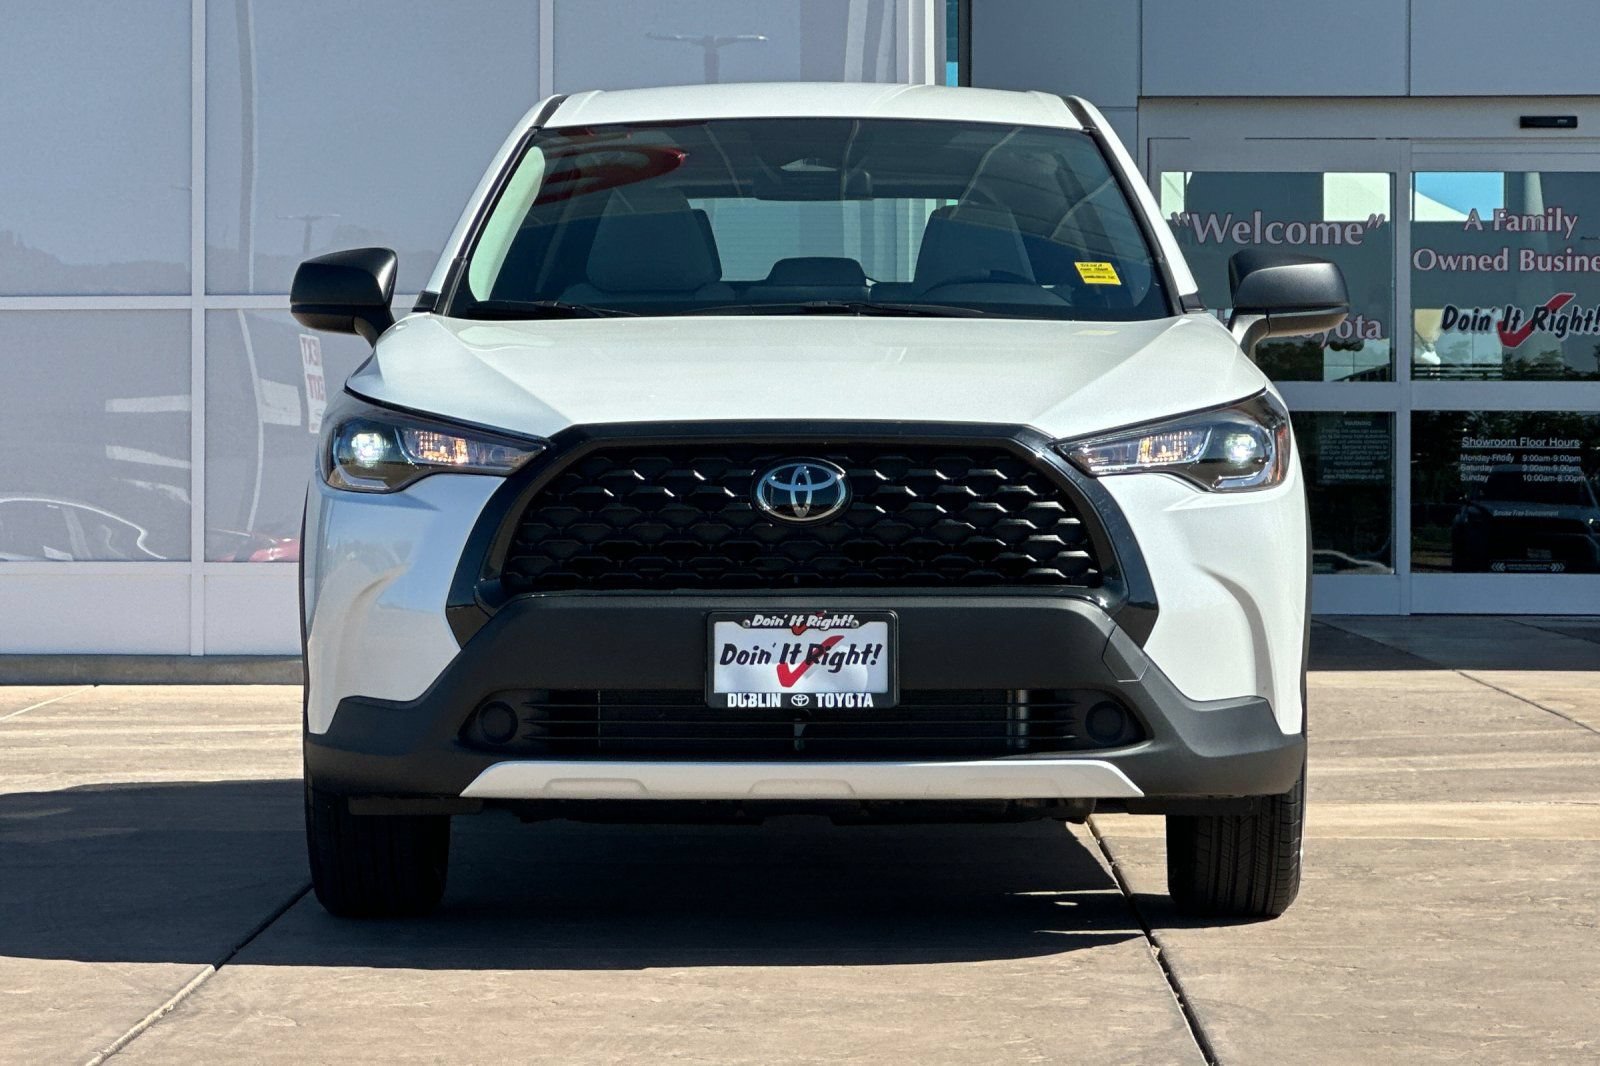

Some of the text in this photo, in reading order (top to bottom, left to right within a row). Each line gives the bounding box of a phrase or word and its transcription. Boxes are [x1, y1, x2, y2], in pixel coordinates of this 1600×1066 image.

[1464, 207, 1578, 239] A Family
[1413, 248, 1509, 272] Owned
[1503, 306, 1521, 331] It
[1531, 306, 1600, 338] Right!
[1462, 437, 1580, 447] Showroom Floor Hours
[1460, 465, 1493, 473] Saturday
[1460, 475, 1489, 483] Sunday
[752, 615, 853, 630] Doin' It Right!
[719, 642, 883, 674] Doin' It Right!
[727, 693, 873, 708] DUBLIN TOYOTA
